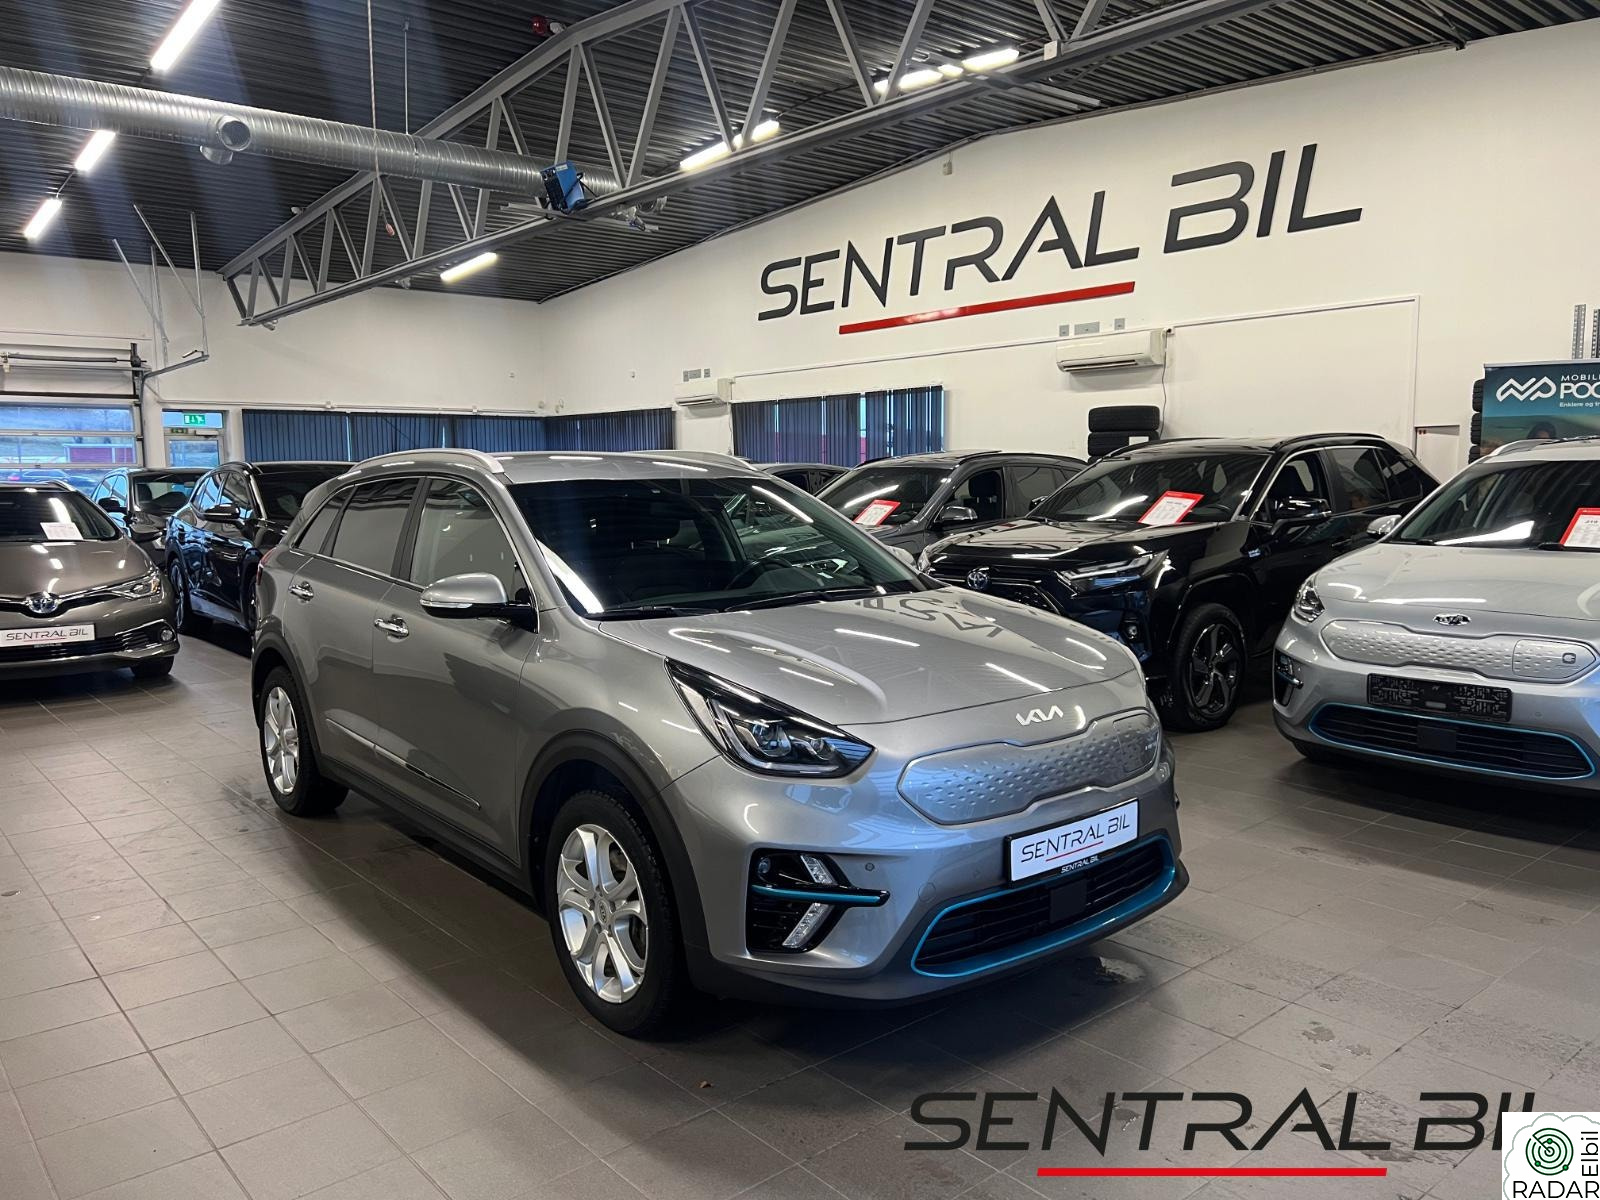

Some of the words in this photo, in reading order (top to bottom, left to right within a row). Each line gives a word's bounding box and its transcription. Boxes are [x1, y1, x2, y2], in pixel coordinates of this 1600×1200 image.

[758, 191, 1139, 322] SENTRAL
[1164, 144, 1363, 254] BIL
[6, 630, 67, 641] SENTRAL
[69, 628, 88, 637] BIL
[1021, 823, 1105, 863] SENTRAL
[1107, 814, 1131, 835] BIL
[1060, 858, 1090, 874] SENTRAL
[1088, 855, 1100, 866] BIL
